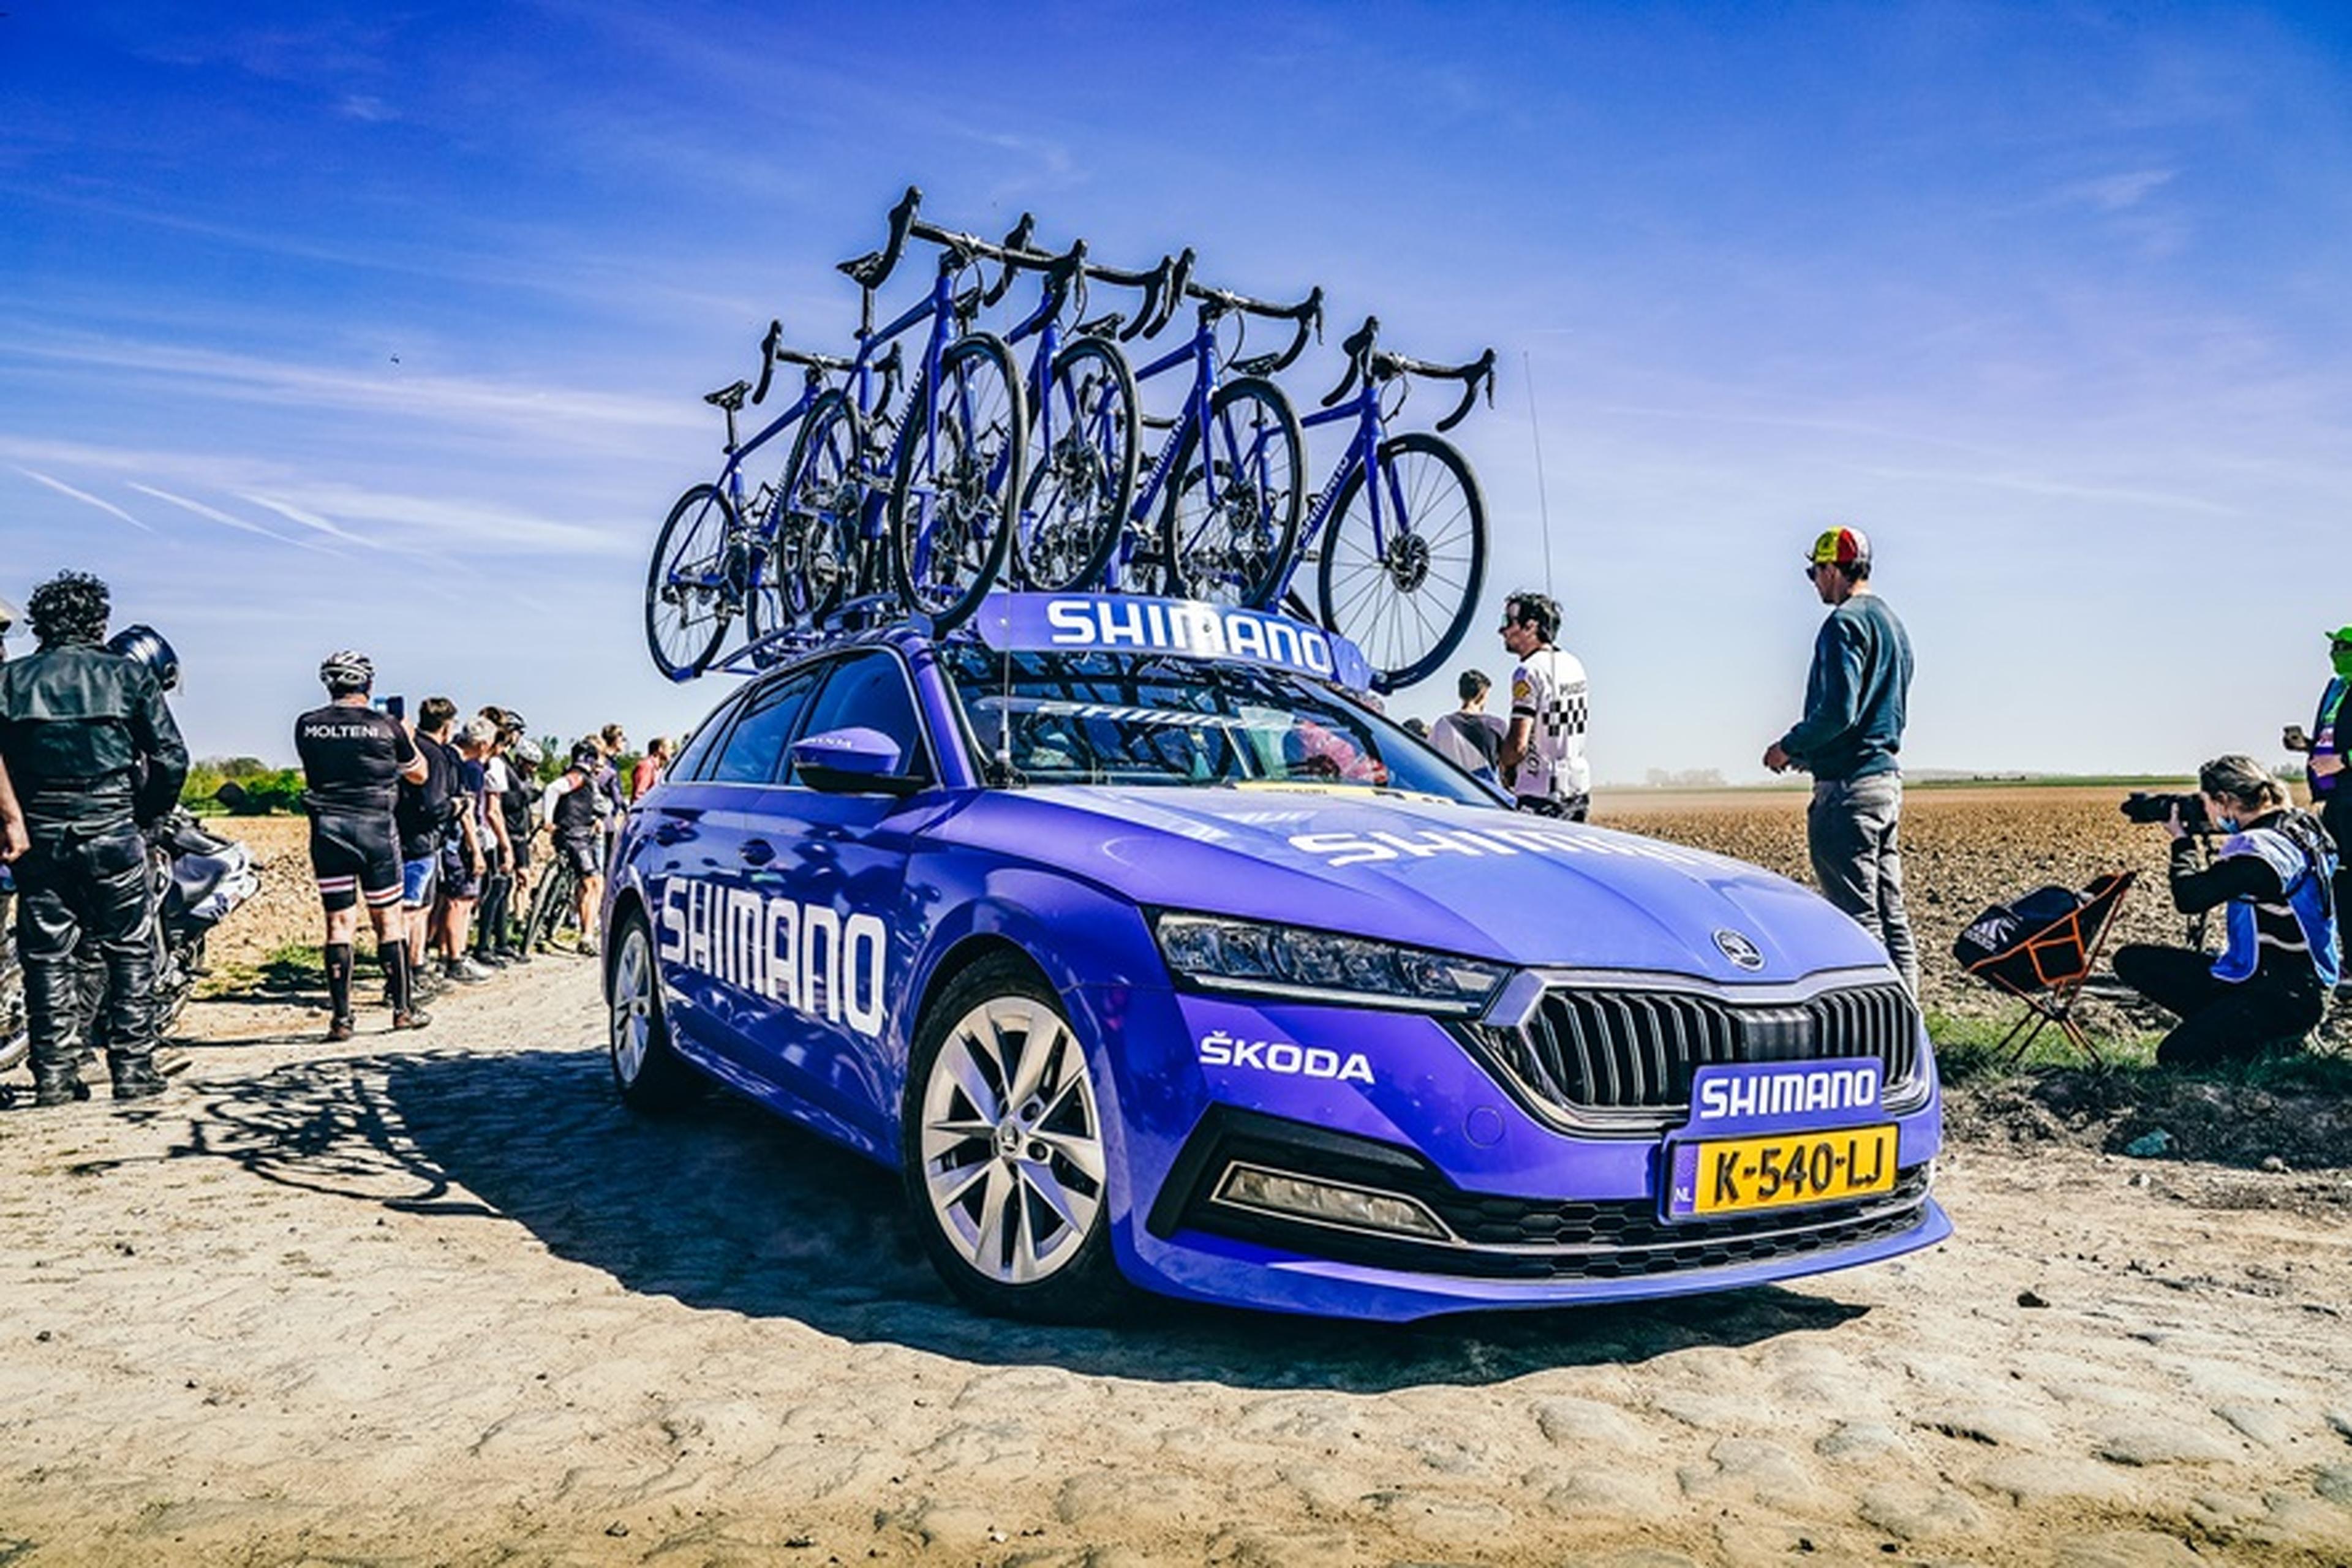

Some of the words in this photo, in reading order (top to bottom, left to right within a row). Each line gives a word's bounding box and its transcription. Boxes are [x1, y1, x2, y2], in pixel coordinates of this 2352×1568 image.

[1047, 600, 1333, 674] SHIMANO
[304, 725, 379, 738] MOLTENI
[661, 876, 886, 1038] SHIMANO
[1199, 1031, 1376, 1084] ŠKODA
[1700, 1069, 1877, 1118] SHIMANO
[1675, 1187, 1692, 1202] NL
[1715, 1137, 1883, 1205] K-540-LJ
